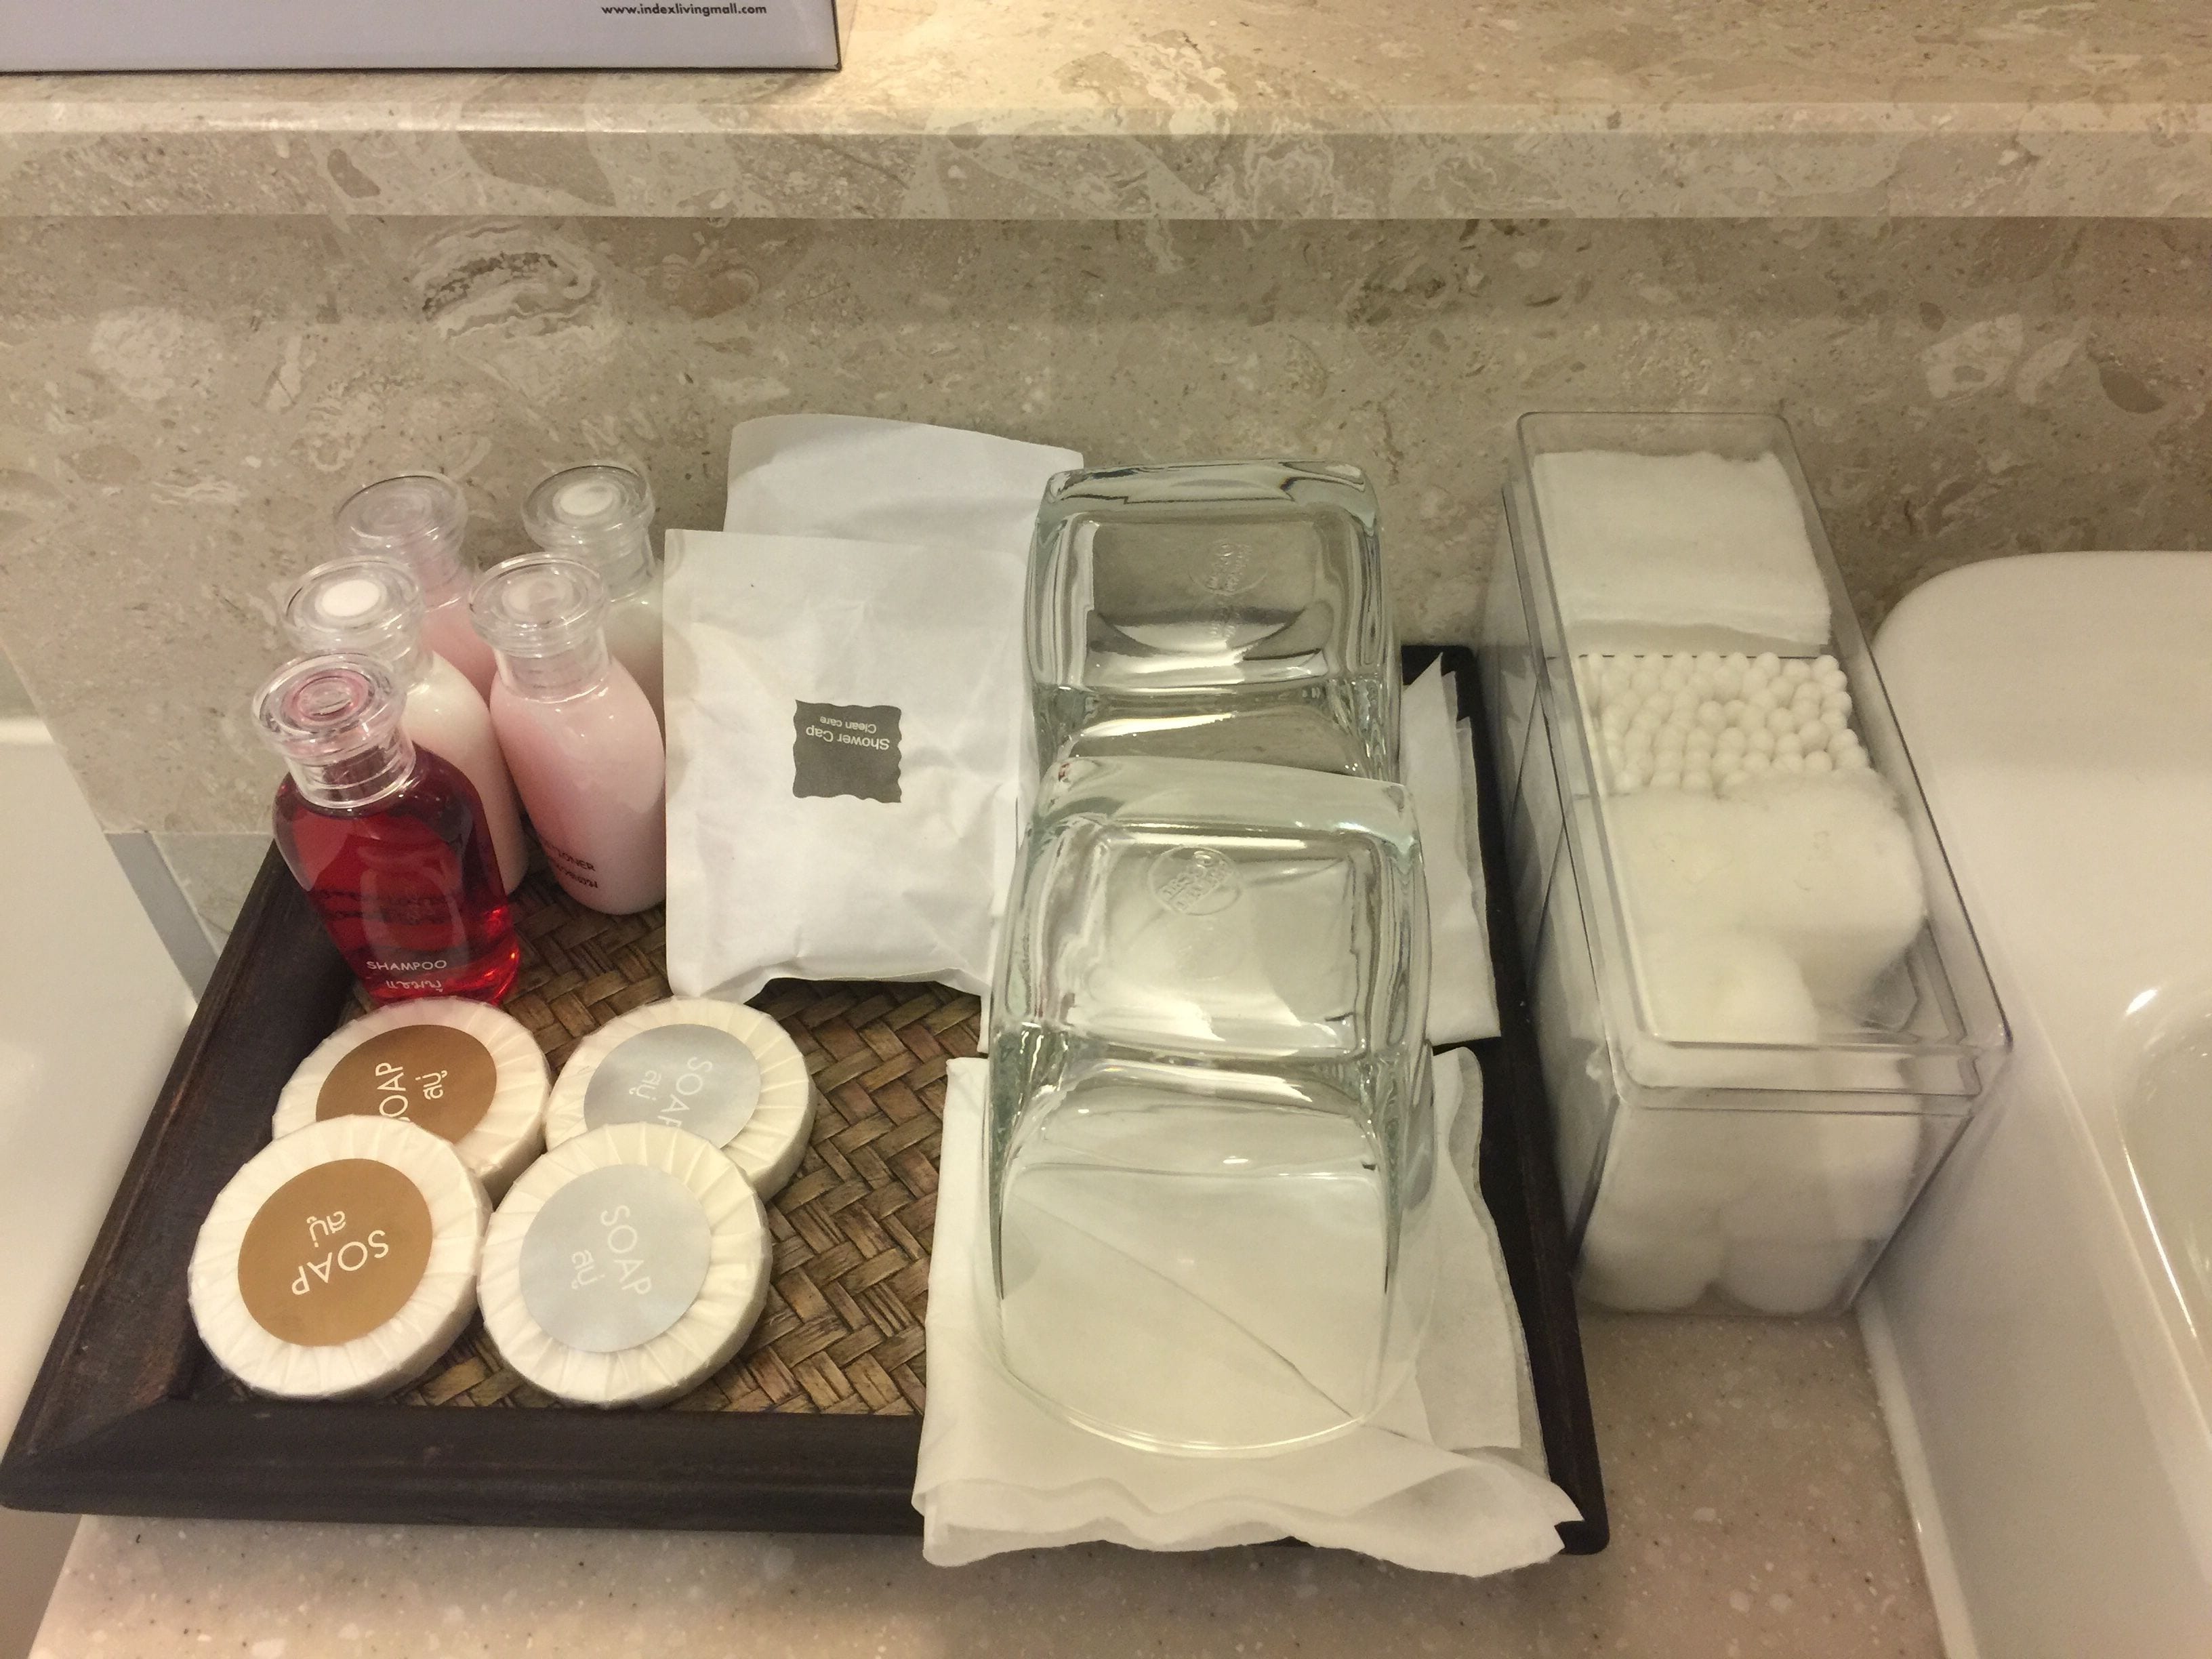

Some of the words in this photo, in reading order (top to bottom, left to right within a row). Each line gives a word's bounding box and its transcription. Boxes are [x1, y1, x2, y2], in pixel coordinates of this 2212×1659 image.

[601, 3, 767, 17] www.indexlivingmall.com
[819, 716, 842, 727] care
[845, 722, 877, 734] Clean
[806, 725, 834, 743] Cap
[837, 733, 890, 751] Shower
[366, 960, 448, 971] SHAMPOO
[386, 980, 443, 992] แชมพู
[415, 1069, 448, 1101] สบู่
[628, 1069, 662, 1101] สบู่
[306, 1210, 346, 1248] สบู่
[600, 1205, 652, 1294] SOAP
[291, 1230, 389, 1295] SOAP
[571, 1250, 605, 1289] สบู่
